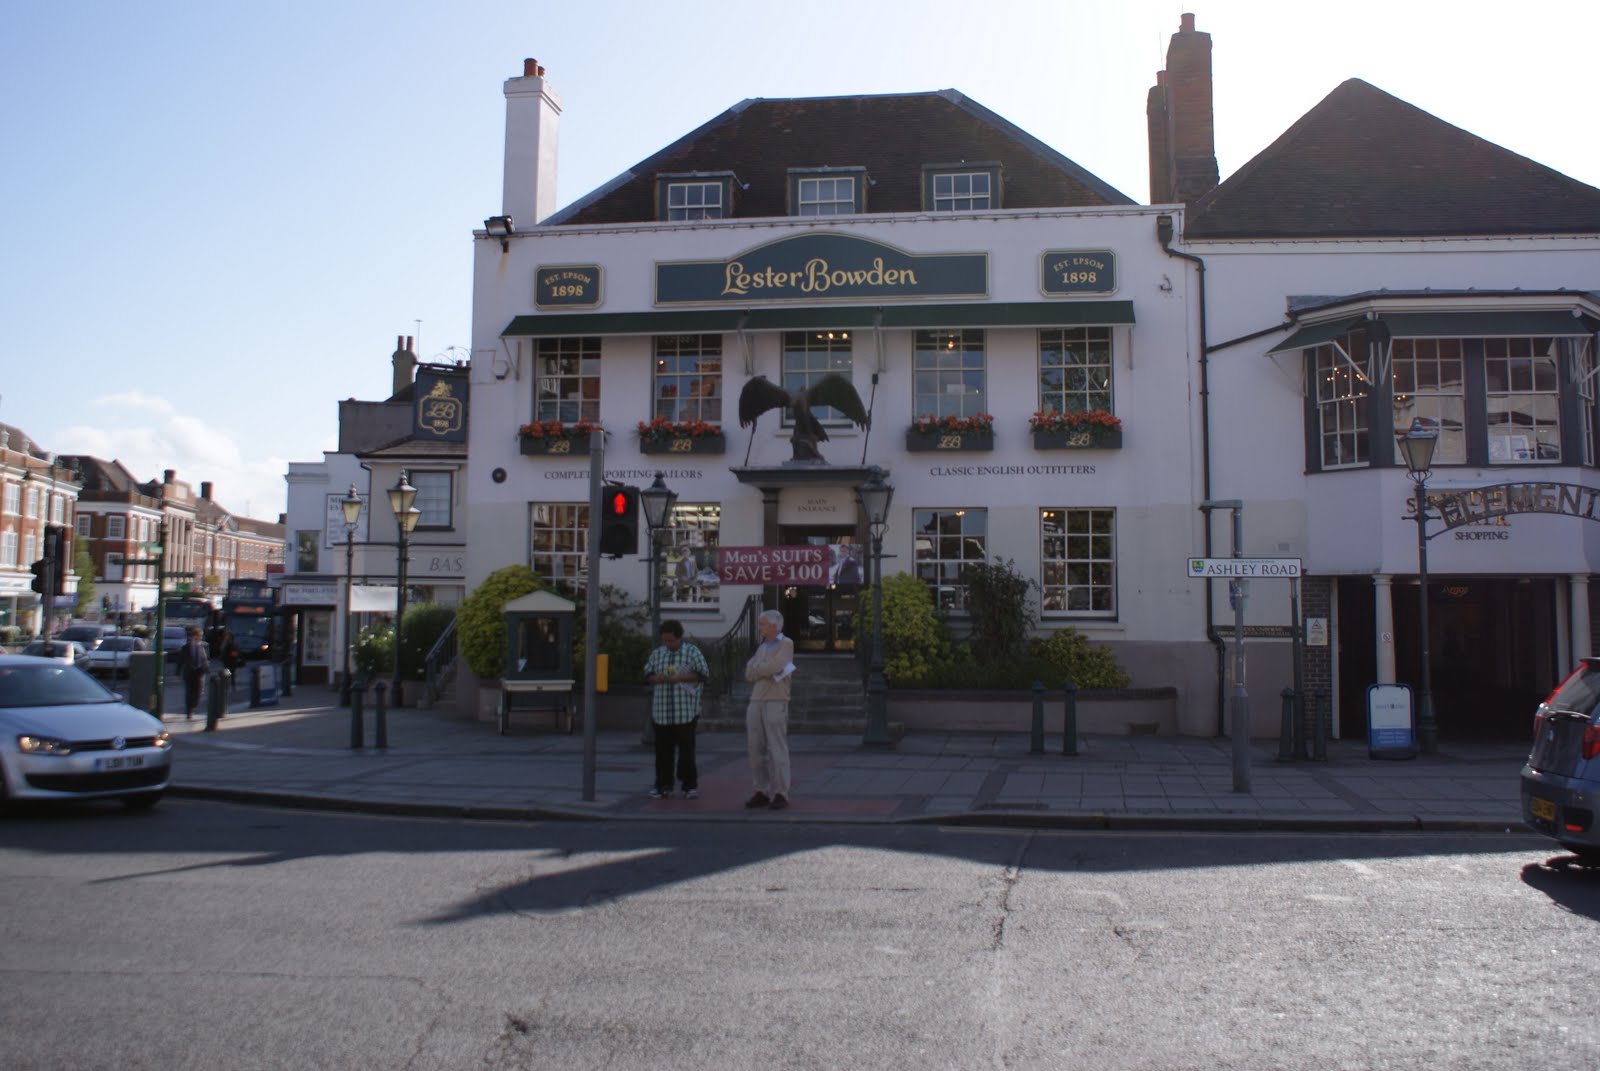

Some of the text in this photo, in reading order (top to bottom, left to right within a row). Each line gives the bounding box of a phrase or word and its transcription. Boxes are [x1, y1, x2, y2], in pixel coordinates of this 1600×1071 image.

[1073, 258, 1104, 270] EPSOM
[563, 272, 592, 284] EPSOM
[721, 257, 918, 296] Lester Bowden
[1062, 272, 1096, 284] 1898
[552, 285, 583, 297] 1898
[544, 470, 592, 480] COMPLET
[603, 470, 652, 480] PORTING
[929, 463, 1096, 477] CLASSIC ENGLISH OUTFITTERS
[1455, 531, 1509, 541] SHOPPING
[725, 549, 823, 564] Men's SUITS
[724, 564, 823, 581] SAVE £100
[1207, 564, 1298, 575] ASHLEY ROAD
